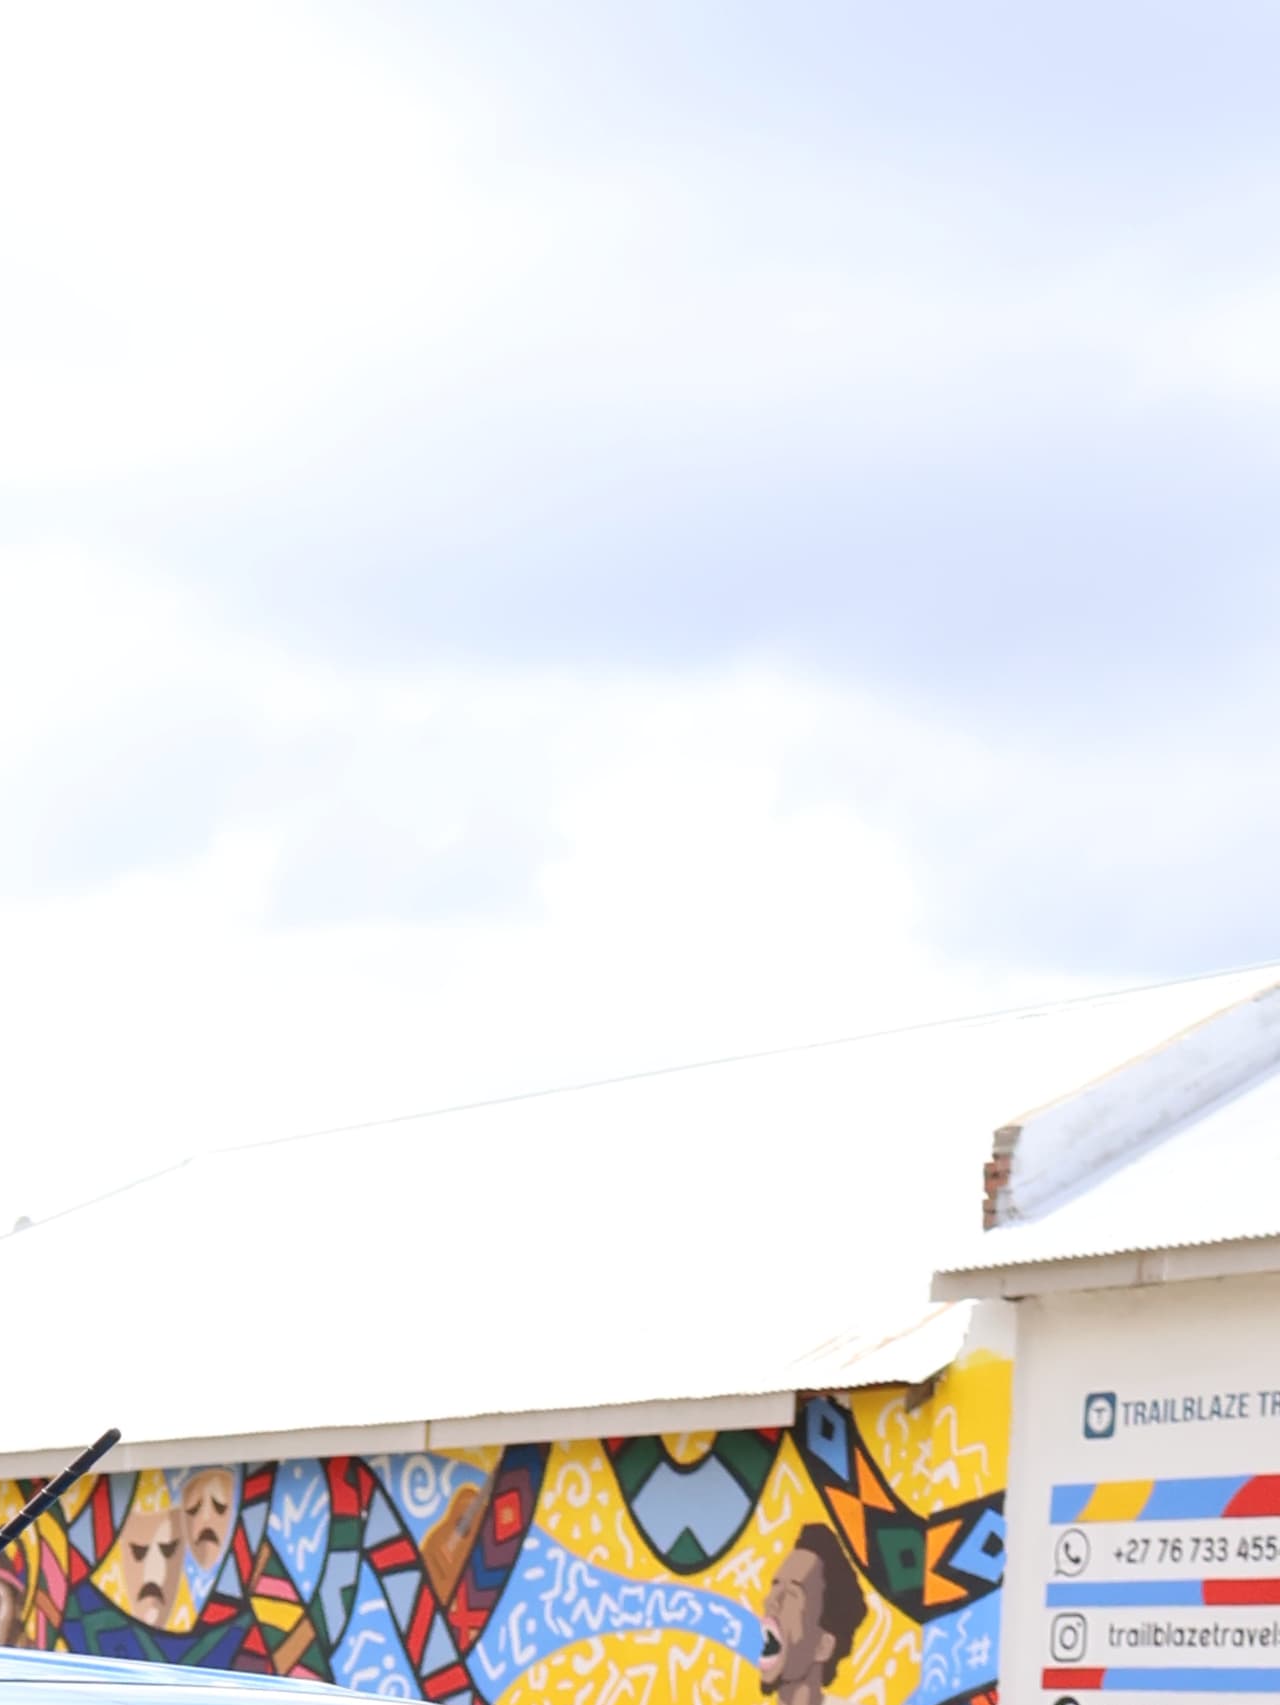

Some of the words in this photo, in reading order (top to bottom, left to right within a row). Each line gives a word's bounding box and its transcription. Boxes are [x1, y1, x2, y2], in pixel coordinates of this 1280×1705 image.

[1122, 1393, 1250, 1427] TRAILBLAZE
[1114, 1537, 1151, 1563] +27
[1157, 1537, 1183, 1563] 76
[1190, 1536, 1228, 1563] 733
[1237, 1536, 1280, 1562] 455
[1108, 1622, 1280, 1648] trailblazetravel
